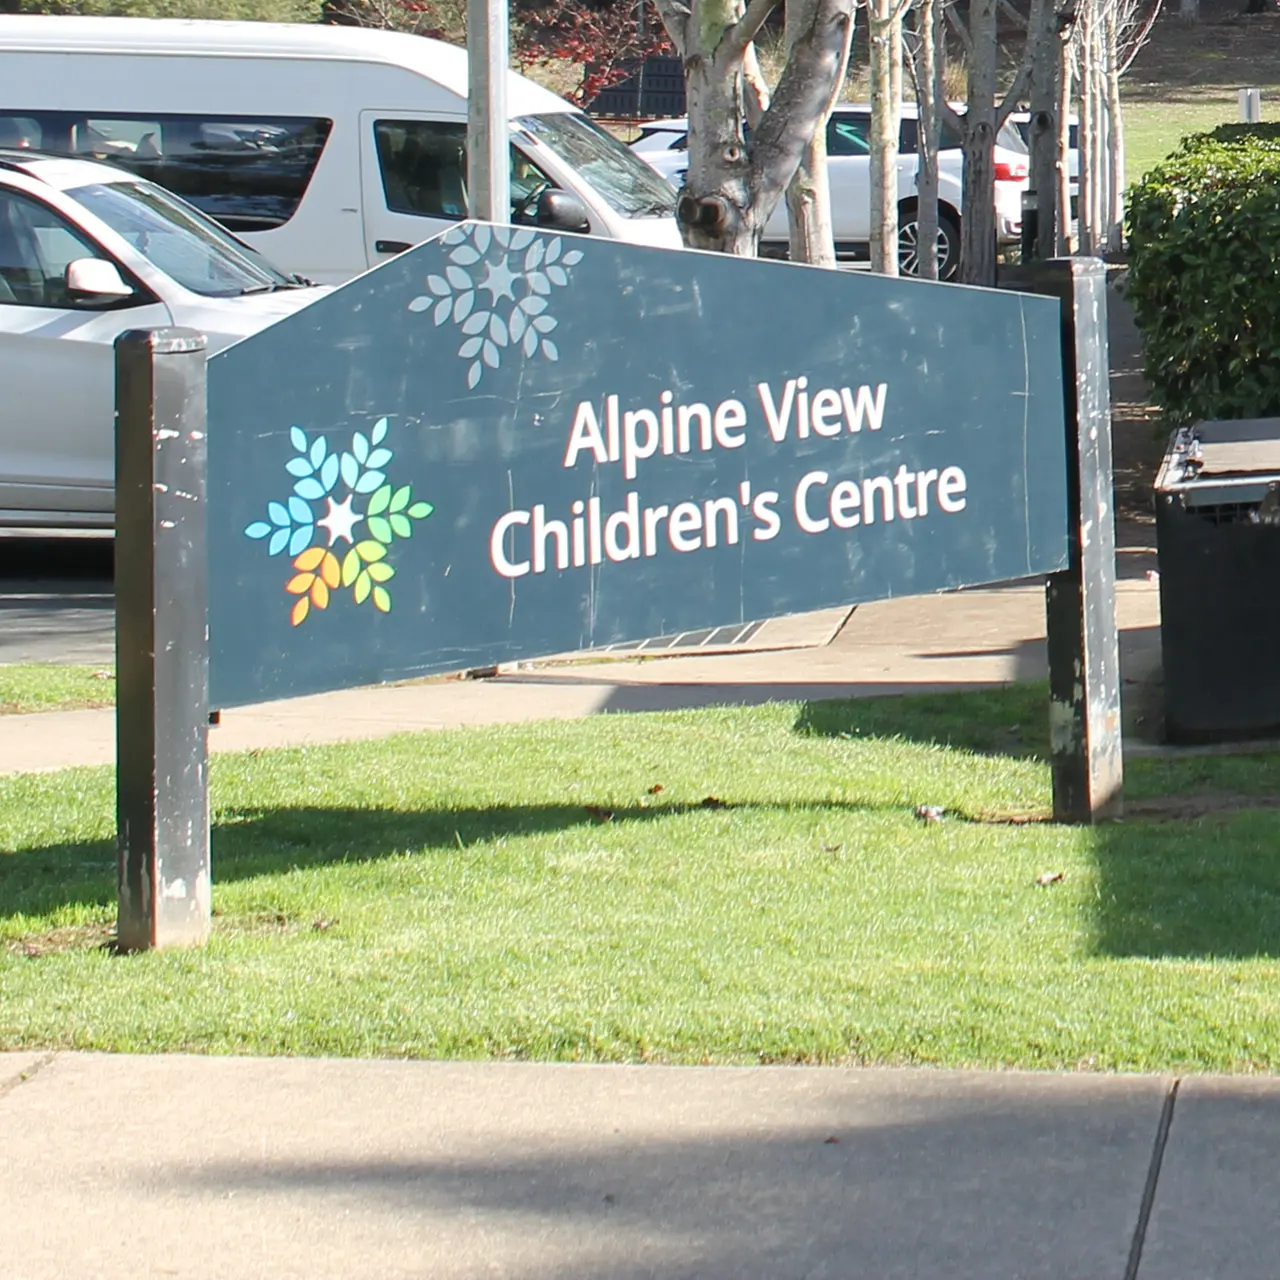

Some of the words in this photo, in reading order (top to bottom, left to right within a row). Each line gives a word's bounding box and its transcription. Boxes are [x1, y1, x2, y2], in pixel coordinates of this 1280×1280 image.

[563, 391, 747, 480] Alpine
[758, 376, 888, 442] View
[490, 481, 781, 577] Children's
[794, 464, 967, 534] Centre
